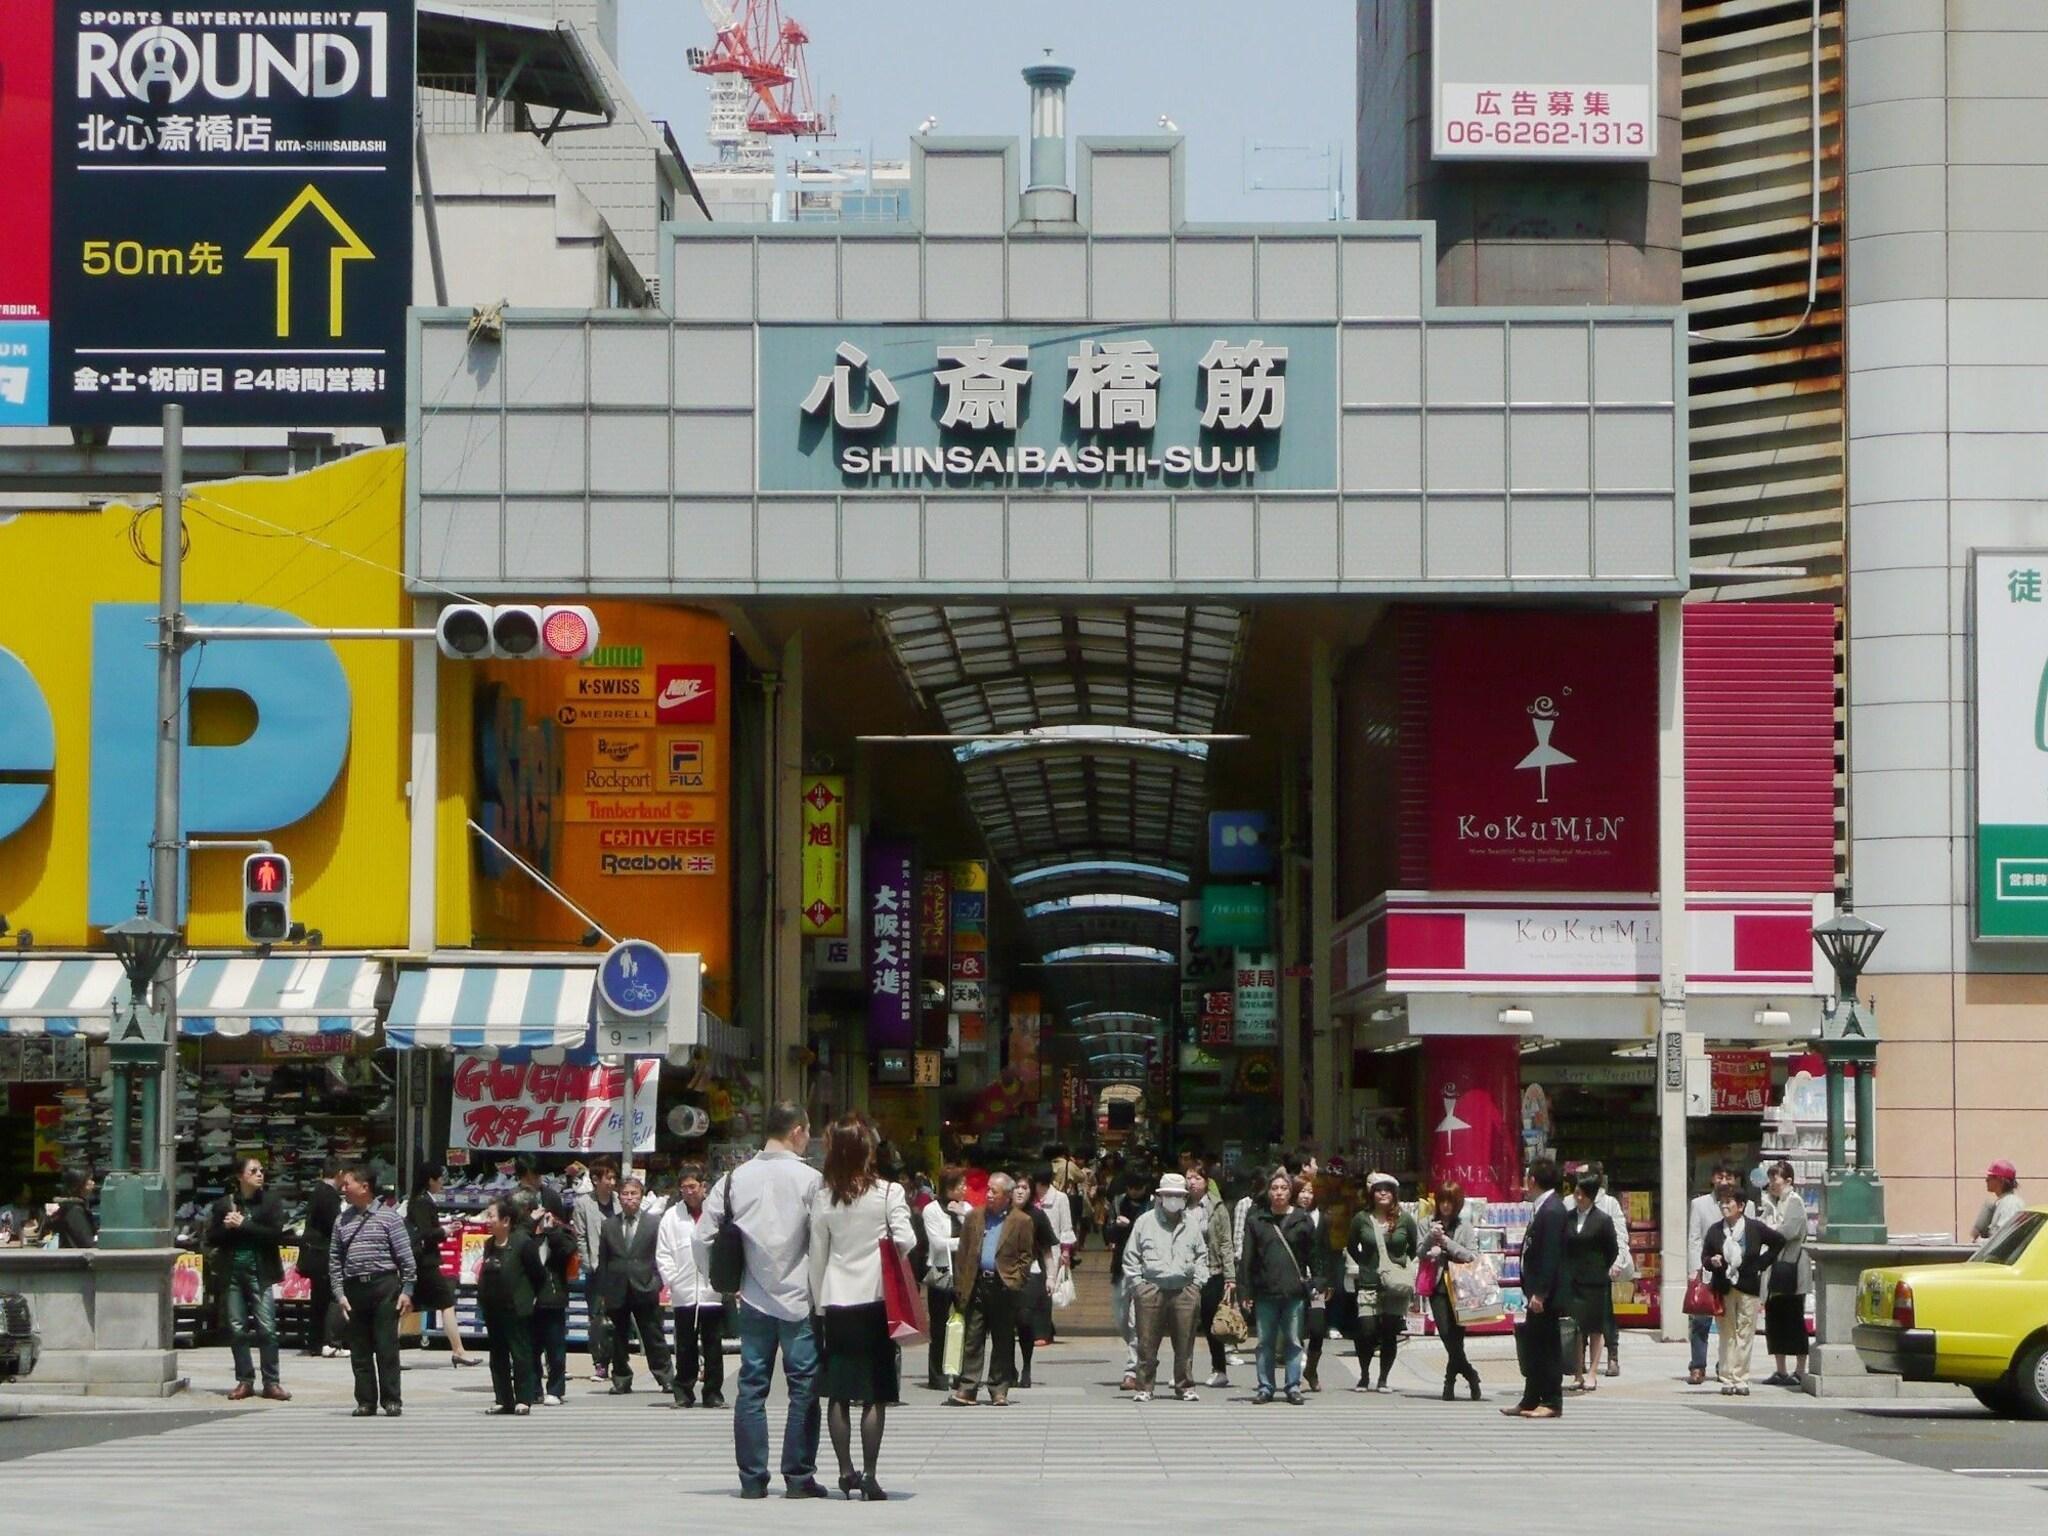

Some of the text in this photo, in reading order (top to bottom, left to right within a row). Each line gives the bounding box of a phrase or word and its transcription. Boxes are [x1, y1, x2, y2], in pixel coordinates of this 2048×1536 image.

[80, 11, 352, 26] SPORTS ENTERTAINMENT
[1475, 90, 1610, 117] 広告募集
[77, 114, 272, 153] 北心斎橋店
[1447, 121, 1645, 145] 06-6262-1313
[275, 140, 388, 153] KITA-SHINSAIBASHI
[82, 241, 224, 276] 50m先
[234, 367, 387, 393] 24時間営業!
[800, 338, 1289, 430] 心斎橋筋
[841, 446, 1256, 474] SHINSAIBASHI-SUJI
[667, 679, 702, 695] NIKE
[580, 711, 651, 720] MERRELL
[586, 769, 651, 792] Rockport
[669, 775, 703, 786] FILA
[587, 800, 672, 819] Timberland
[600, 829, 715, 848] CONVERSE
[601, 855, 682, 875] Reebok
[873, 885, 901, 995] 大阪大進
[1515, 917, 1662, 944] KoKuMi
[1237, 969, 1275, 988] 薬局
